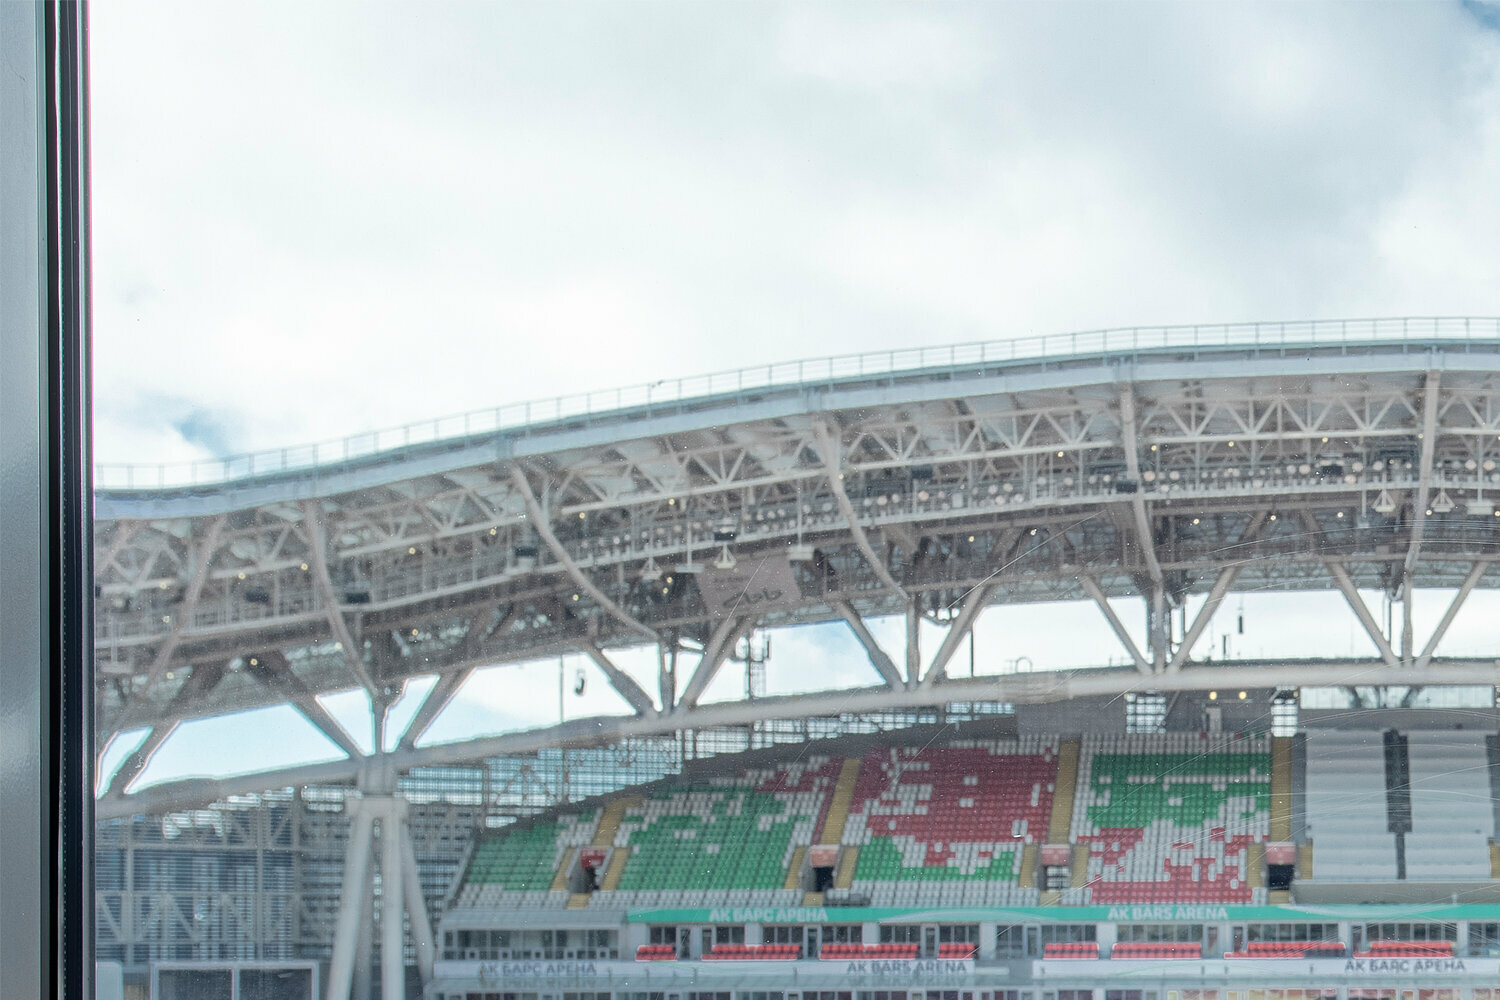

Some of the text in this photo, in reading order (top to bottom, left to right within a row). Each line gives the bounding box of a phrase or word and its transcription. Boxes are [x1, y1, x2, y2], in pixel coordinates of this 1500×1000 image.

[709, 908, 829, 922] АК БАРС АРЕНА
[1107, 906, 1229, 920] AK BARS ARENA
[502, 961, 542, 977] БАРС
[546, 961, 598, 977] АРЕНА
[846, 960, 967, 974] AK BARS ARENA
[1344, 960, 1466, 974] АК БАРС АРЕНА
